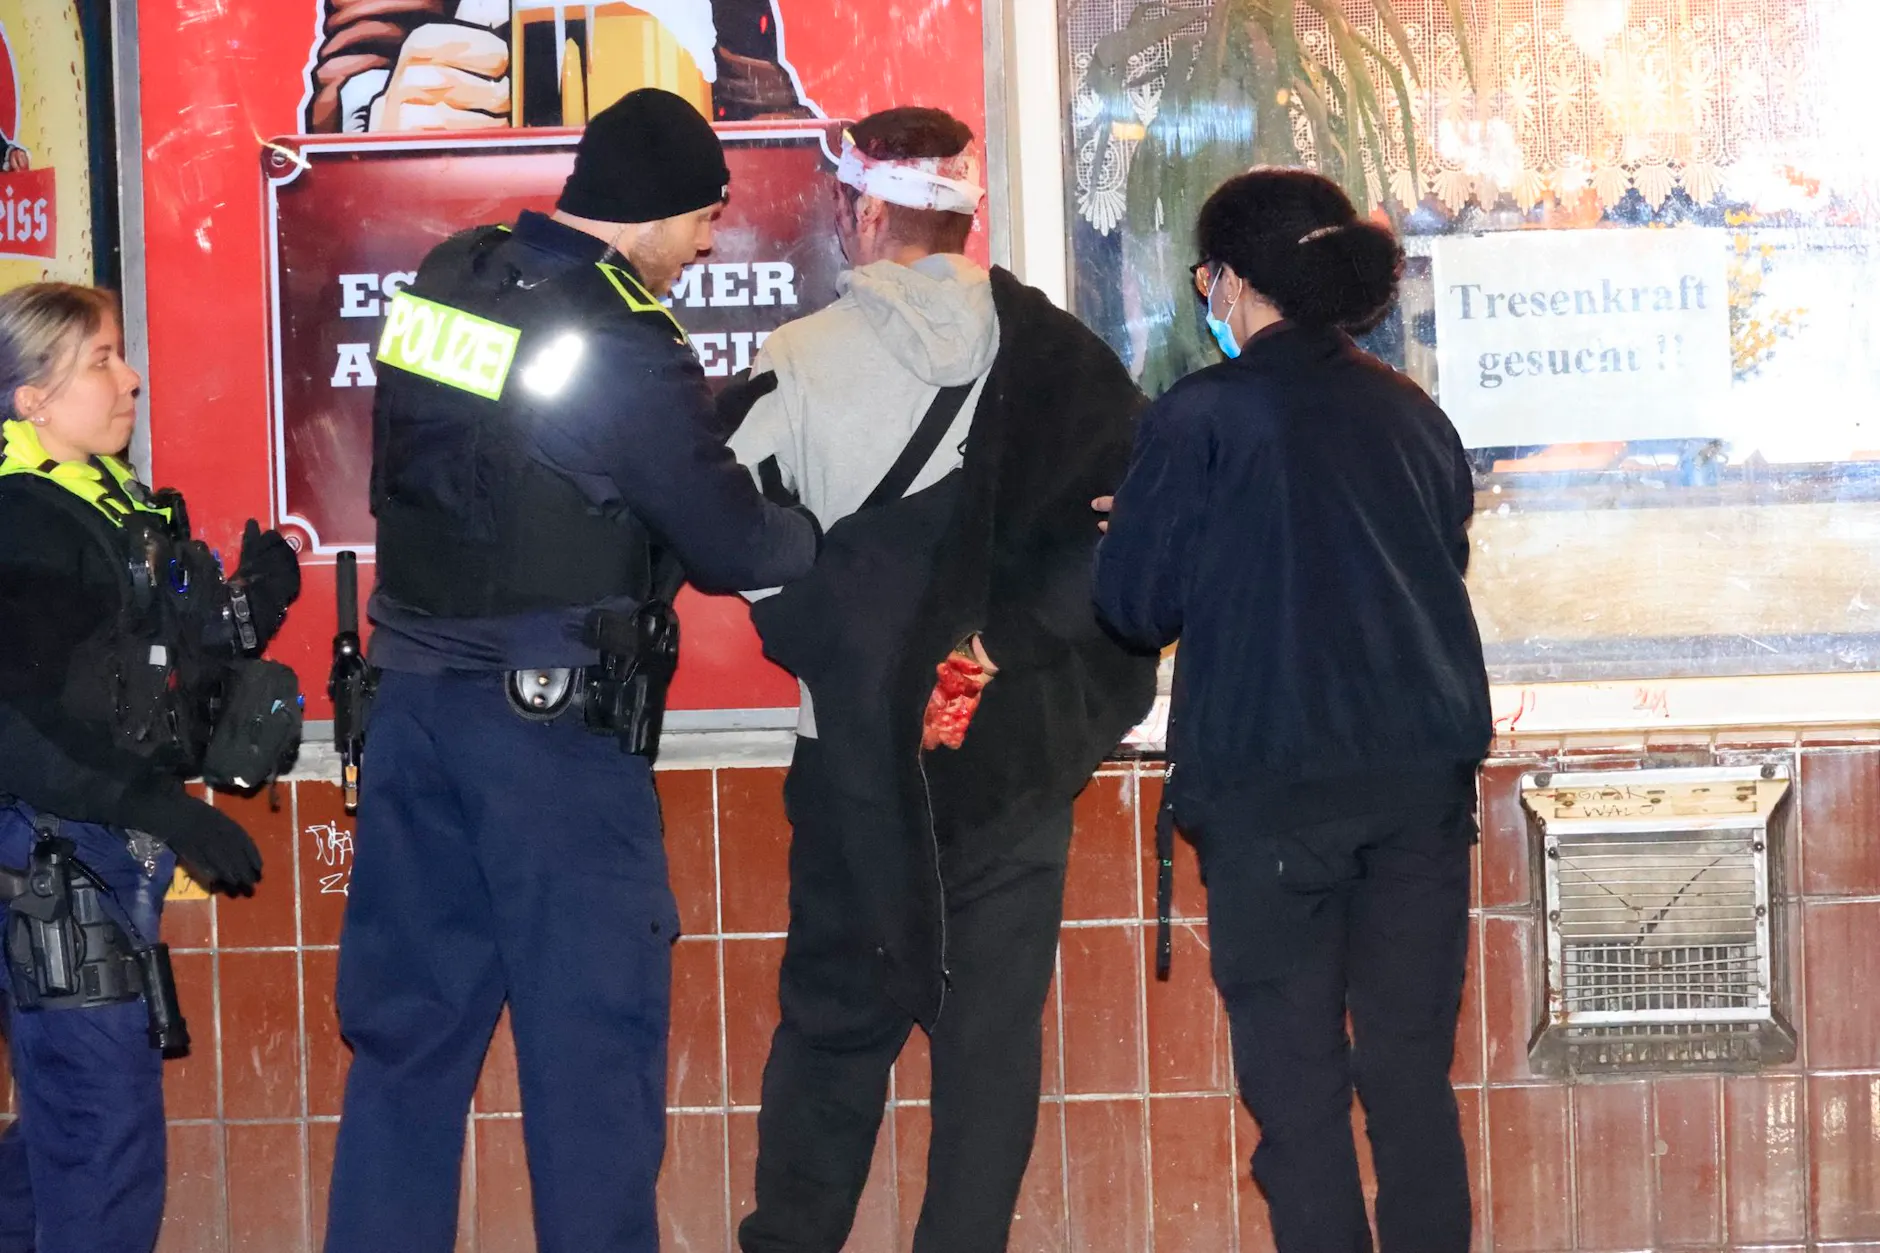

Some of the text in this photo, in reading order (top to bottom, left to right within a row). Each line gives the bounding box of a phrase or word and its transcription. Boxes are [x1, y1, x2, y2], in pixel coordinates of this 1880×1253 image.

[1449, 274, 1710, 320] Tresenkraft
[379, 297, 515, 394] POLIZEI
[1478, 339, 1642, 389] gesucht
